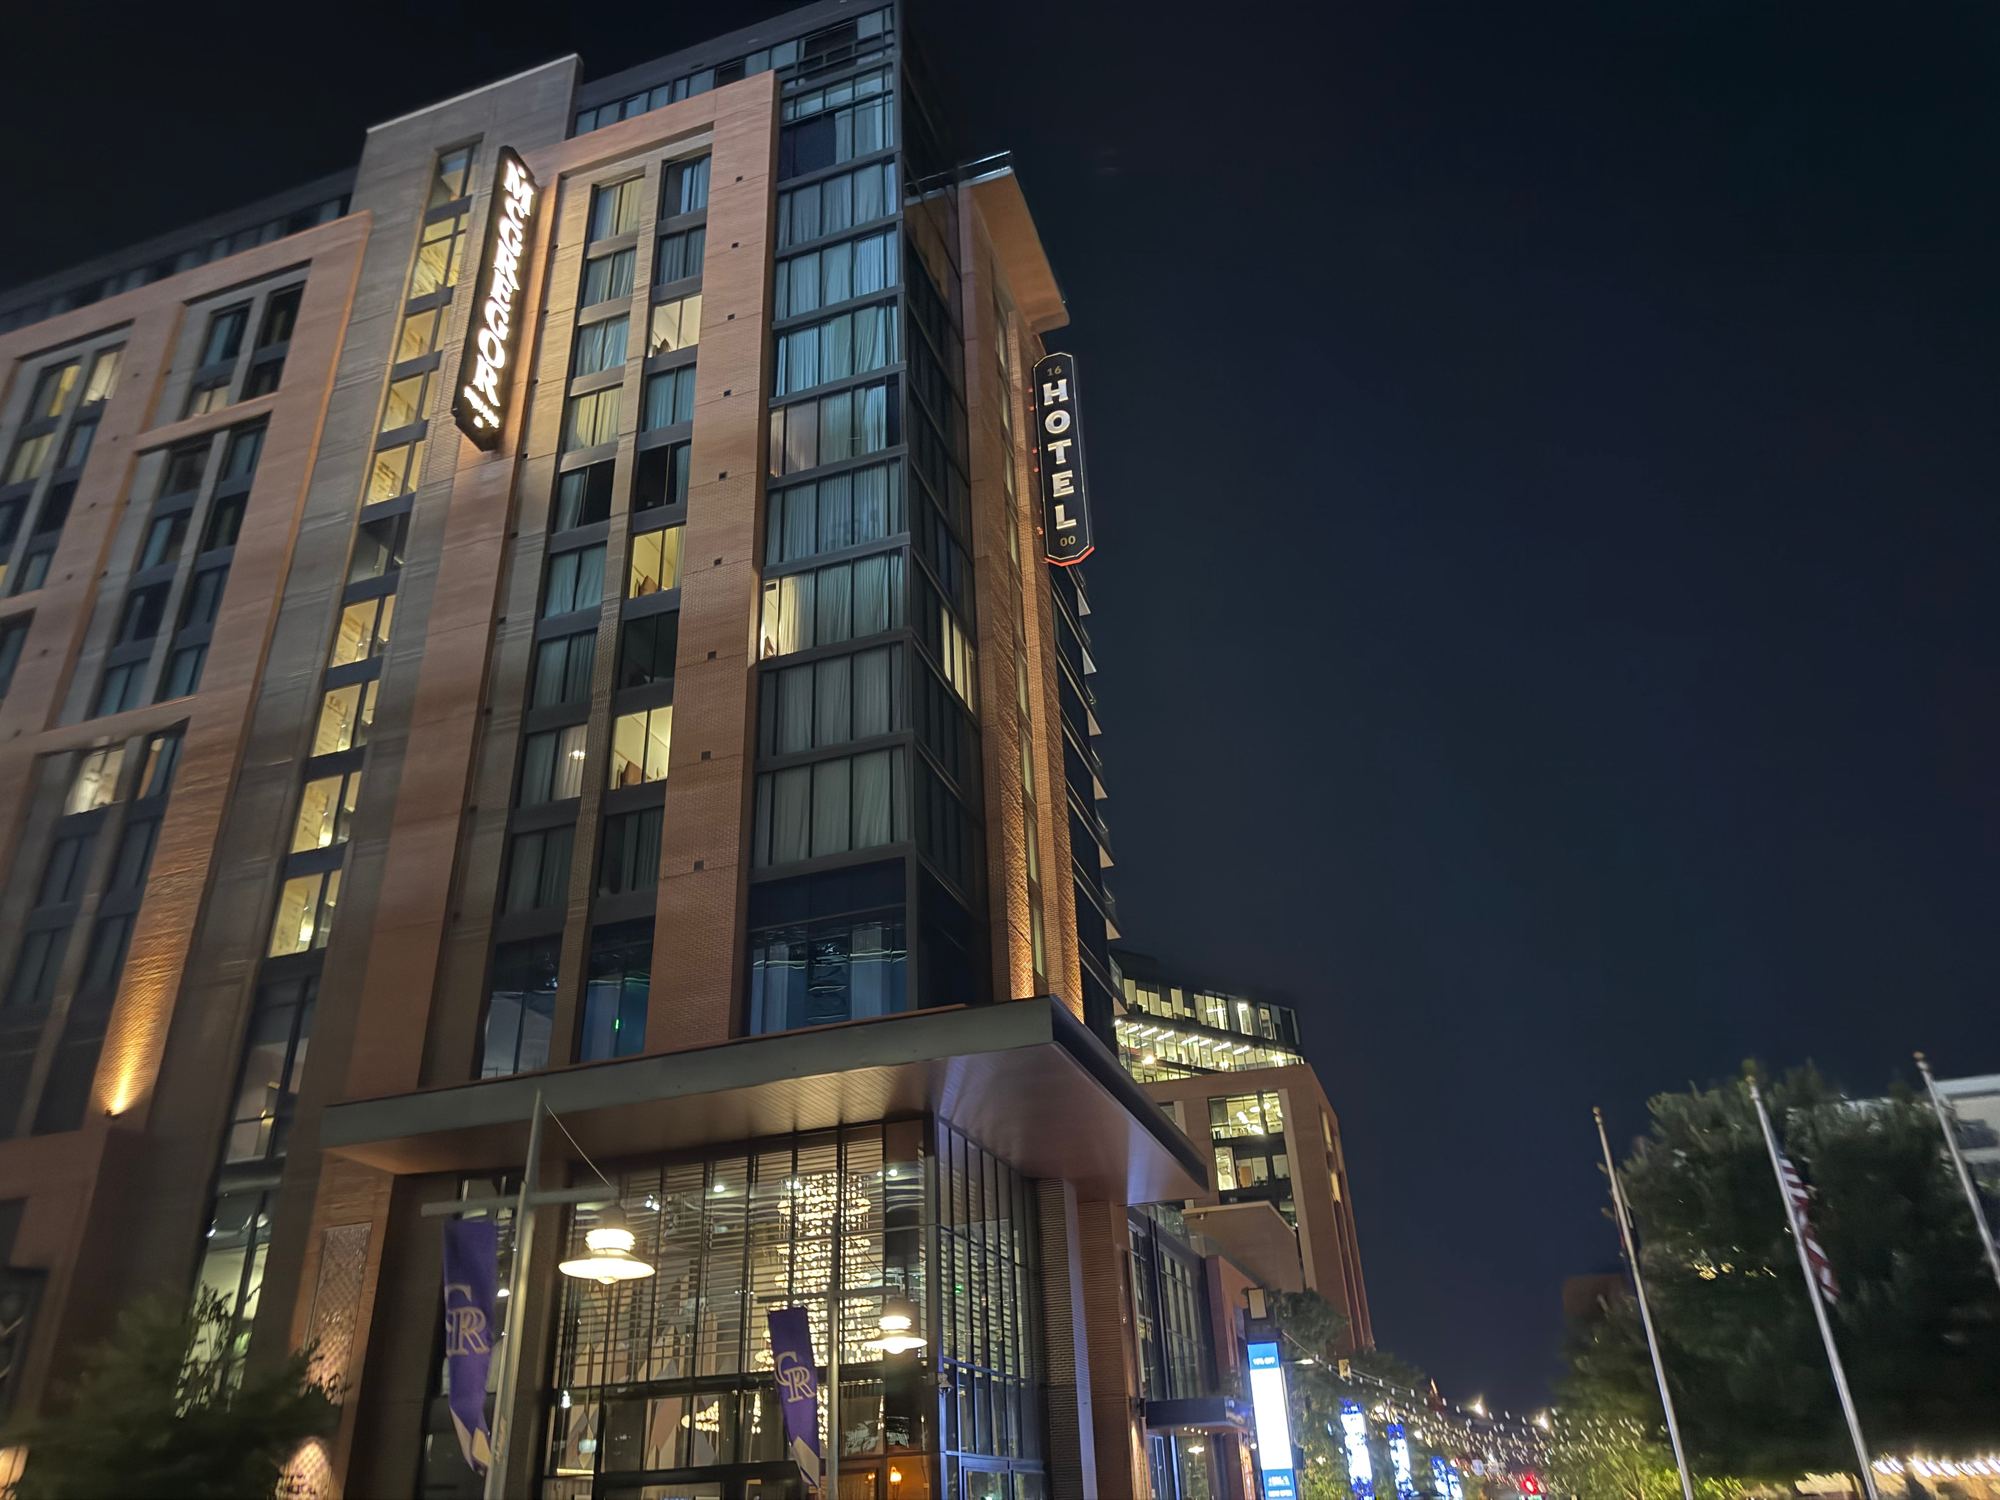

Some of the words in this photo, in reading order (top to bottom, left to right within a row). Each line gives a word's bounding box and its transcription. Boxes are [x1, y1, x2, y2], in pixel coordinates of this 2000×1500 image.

[1047, 365, 1062, 377] 16
[1042, 378, 1077, 530] HOTEL
[1059, 535, 1076, 547] 00
[774, 1351, 816, 1403] CR
